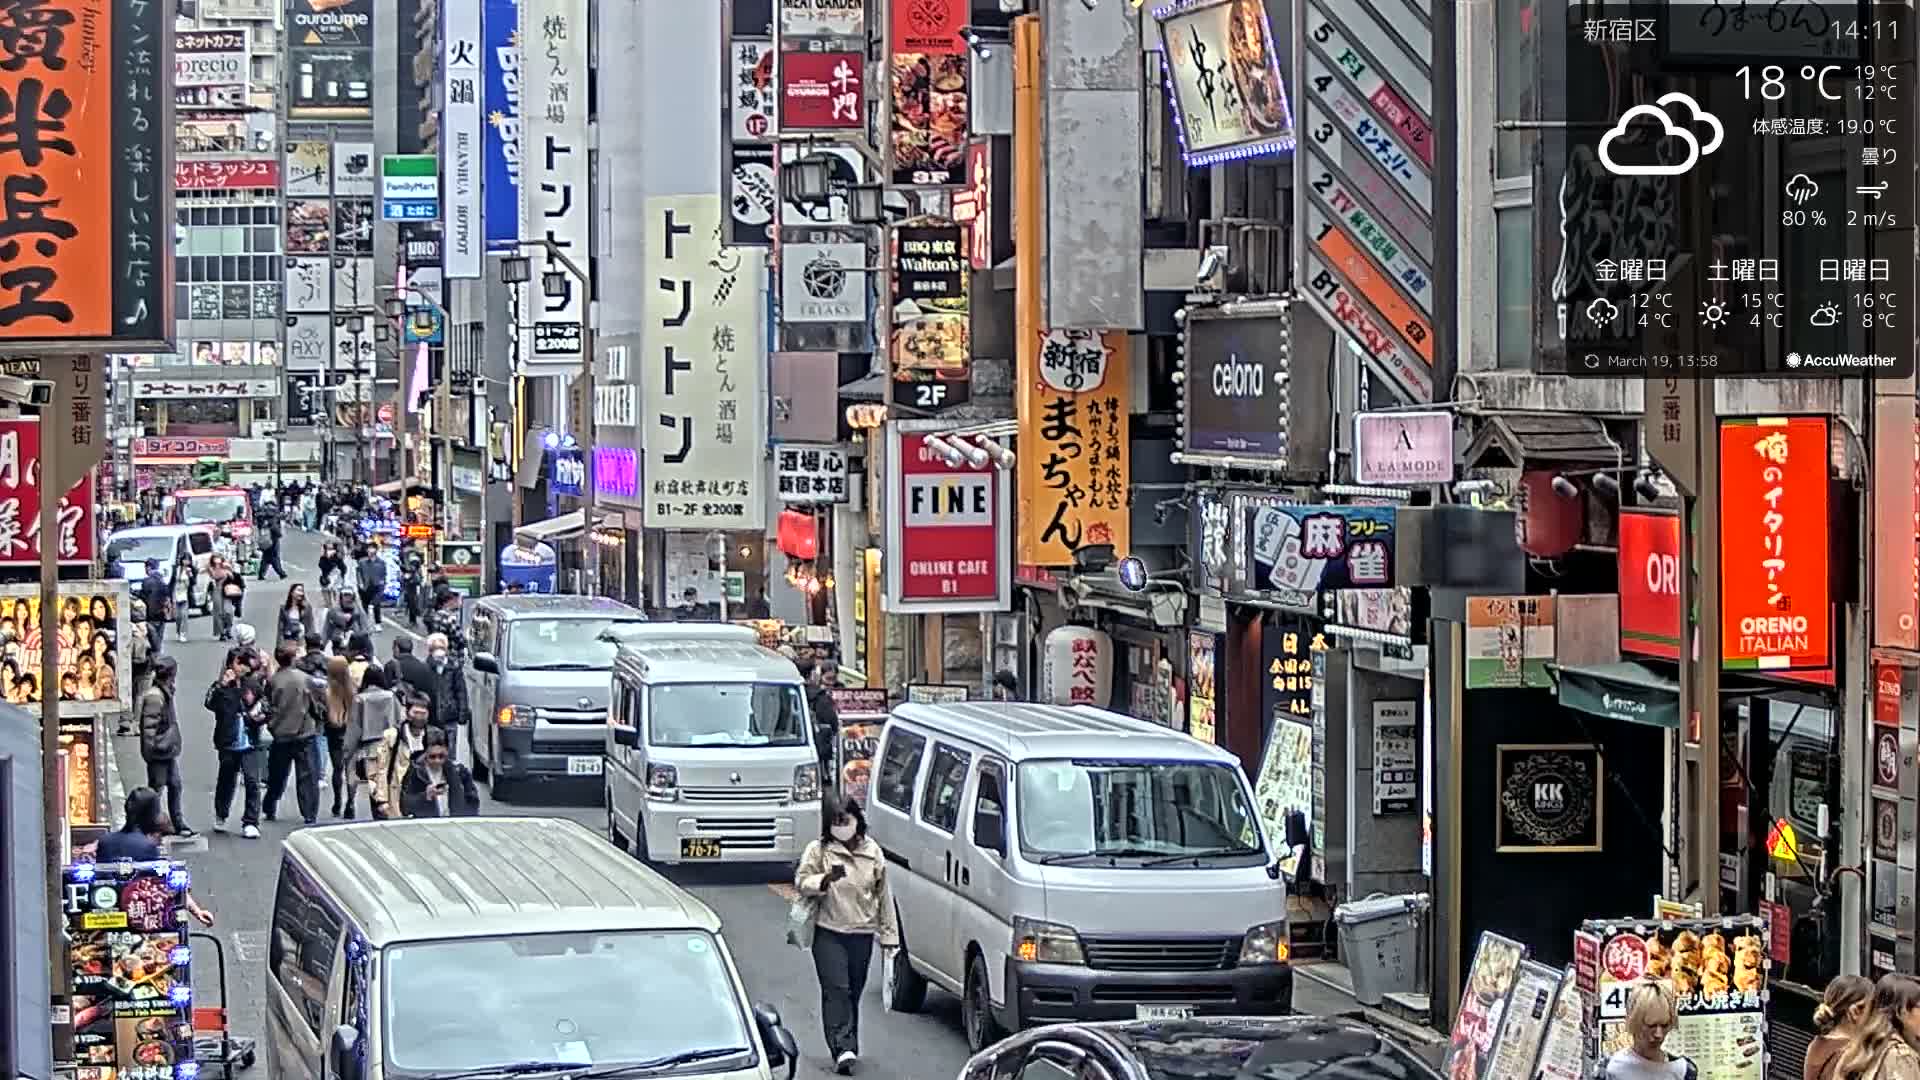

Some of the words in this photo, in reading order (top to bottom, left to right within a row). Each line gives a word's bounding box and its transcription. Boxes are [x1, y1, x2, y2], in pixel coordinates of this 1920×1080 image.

[295, 13, 368, 25] auralume
[1313, 23, 1335, 43] 5
[450, 40, 474, 104] 火鍋
[543, 16, 569, 124] 焼とん酒場
[830, 60, 859, 121] 牛門
[1314, 75, 1334, 93] 4
[1314, 123, 1334, 144] 3
[1356, 118, 1412, 180] センチュリー
[457, 132, 468, 195] HUANHUA
[386, 182, 435, 192] FamilyMart
[1312, 173, 1333, 194] 2
[406, 204, 434, 216] たばこ
[457, 204, 468, 255] HOTPOT
[1316, 223, 1333, 242] 1
[901, 256, 959, 273] Walton's
[1311, 270, 1340, 299] B1
[659, 209, 692, 464] トントン
[1044, 340, 1103, 371] 新宿
[711, 324, 737, 445] 焼とん酒場
[1063, 373, 1085, 389] の
[1212, 353, 1264, 397] celona
[71, 354, 92, 446] 通り一番街
[916, 384, 947, 406] 2F
[778, 451, 844, 473] 酒場心
[1402, 459, 1445, 472] MODE
[1040, 396, 1085, 550] まっちゃん
[653, 479, 750, 496] 新宿歌舞伎町店
[778, 474, 845, 495] 新宿本店
[911, 485, 986, 514] FINE
[1349, 519, 1390, 537] フリー
[1753, 431, 1790, 605] 俺のイタリアン
[1302, 513, 1388, 584] 麻雀
[910, 561, 953, 576] ONLINE
[957, 560, 988, 575] CAFE
[942, 580, 957, 594] B1
[1739, 616, 1808, 634] ORENO
[1739, 635, 1808, 653] ITALIAN
[1534, 783, 1564, 801] KK
[1677, 990, 1760, 1011] 炭火焼き鳥
